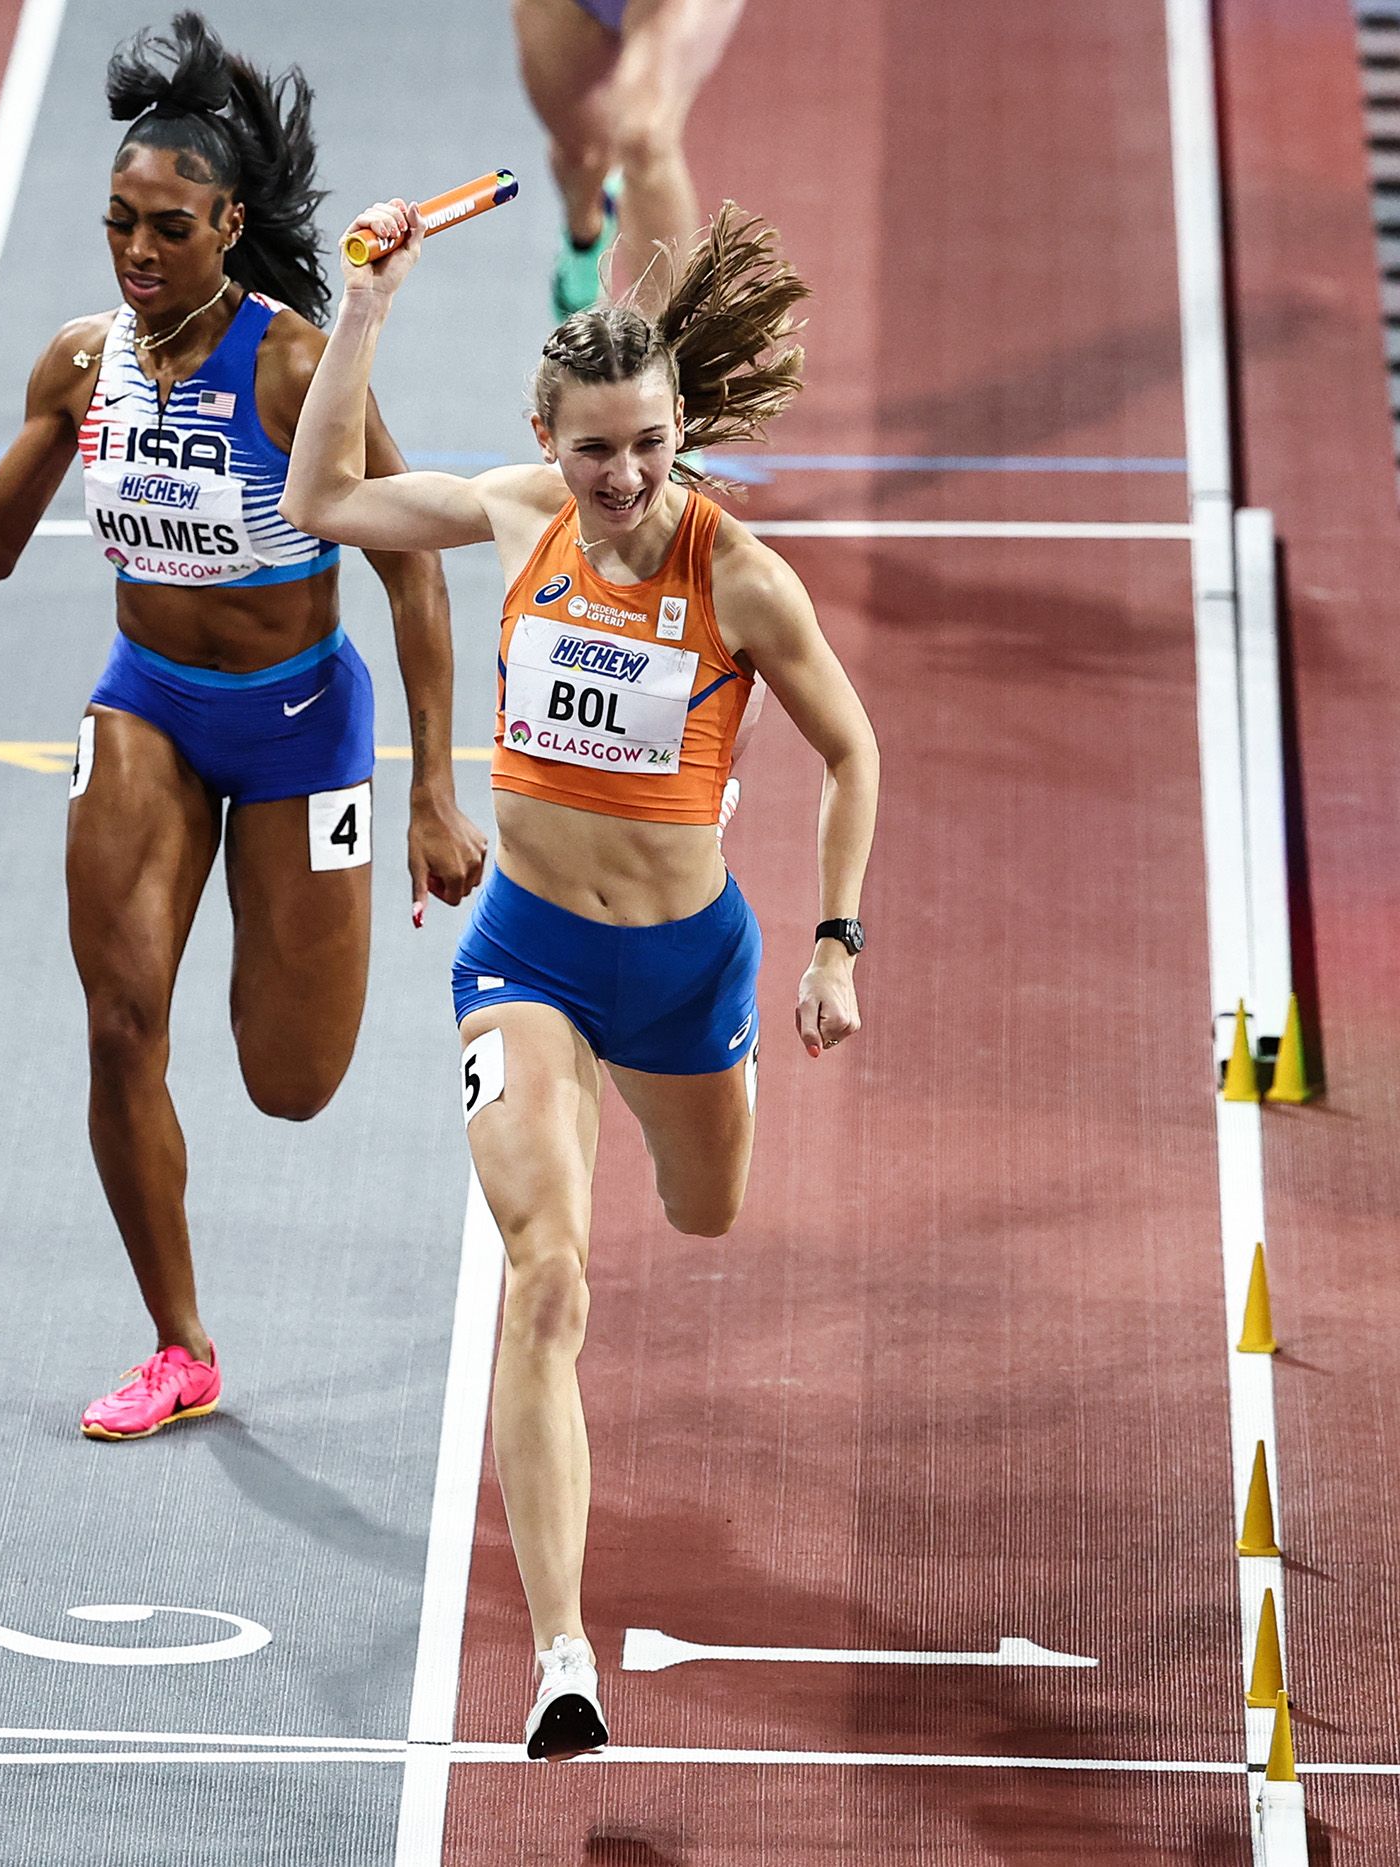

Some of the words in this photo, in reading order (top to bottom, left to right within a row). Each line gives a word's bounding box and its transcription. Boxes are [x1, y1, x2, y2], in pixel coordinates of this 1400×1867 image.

[100, 426, 227, 476] USA
[96, 508, 240, 556] HOLMES
[135, 557, 222, 579] GLASGOW
[586, 611, 626, 628] LOTERIJ
[588, 602, 648, 623] NEDERLANDSE
[547, 680, 626, 735] BOL
[537, 731, 643, 763] GLASGOW
[647, 748, 674, 764] 24
[330, 803, 357, 855] 4
[464, 1053, 481, 1111] 5
[621, 1628, 1099, 1672] 1
